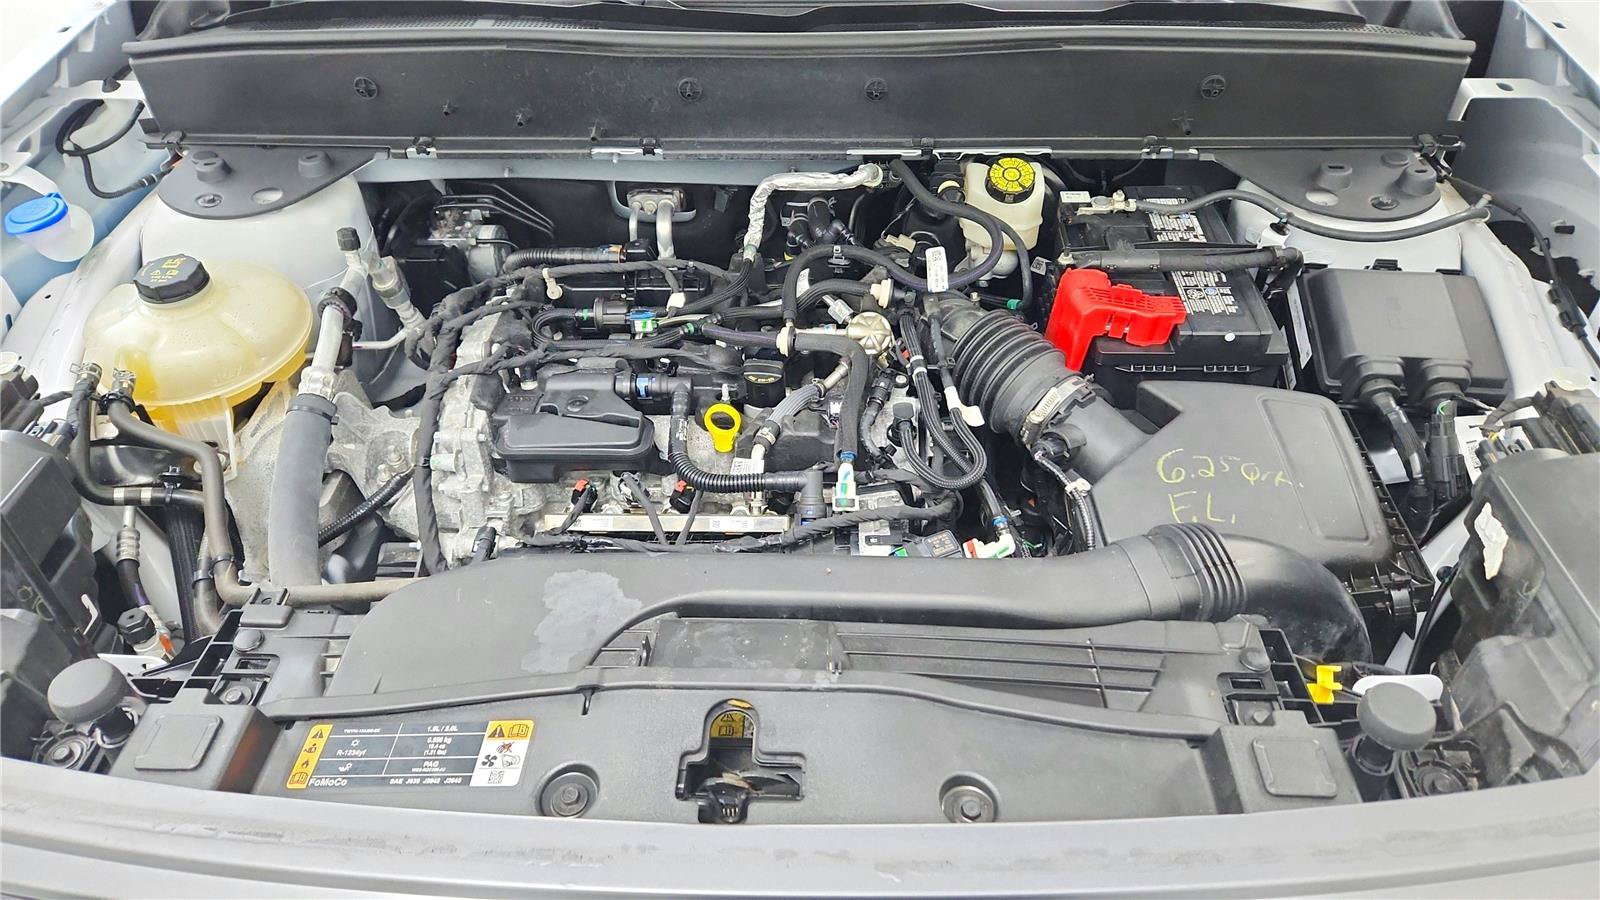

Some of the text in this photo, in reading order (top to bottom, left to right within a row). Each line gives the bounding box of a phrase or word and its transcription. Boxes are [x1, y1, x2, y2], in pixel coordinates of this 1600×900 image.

[1156, 448, 1241, 483] 6.25
[444, 736, 453, 744] kg
[336, 749, 367, 757] R-1234yf
[308, 778, 348, 787] FoMoCo
